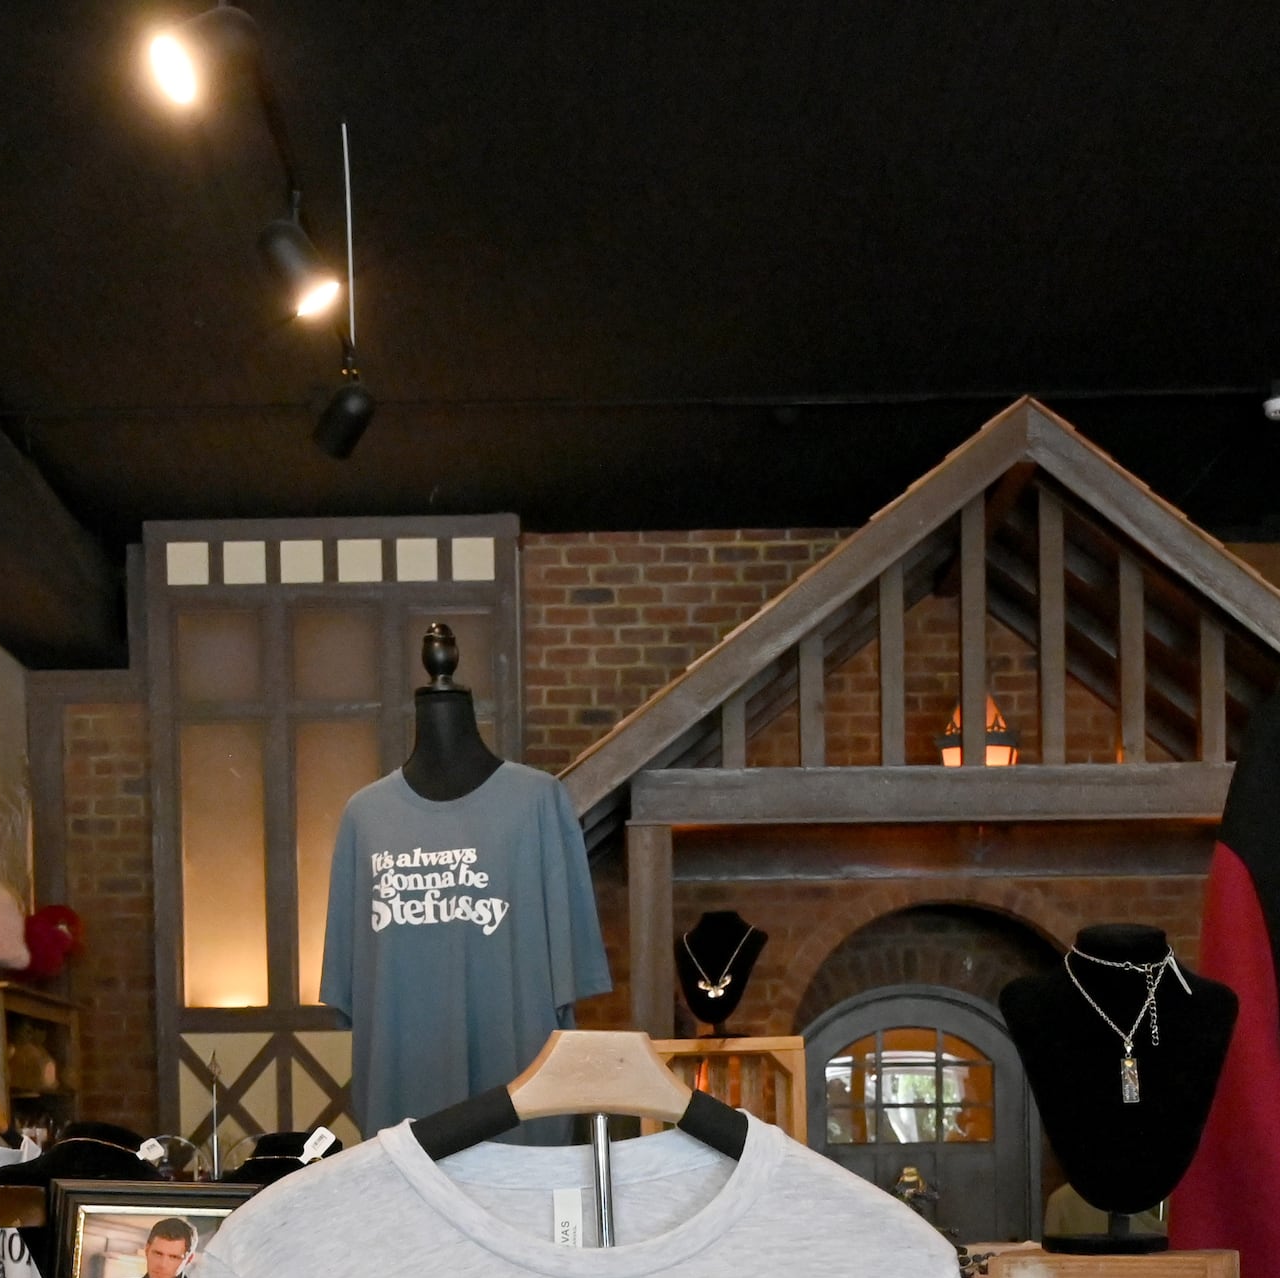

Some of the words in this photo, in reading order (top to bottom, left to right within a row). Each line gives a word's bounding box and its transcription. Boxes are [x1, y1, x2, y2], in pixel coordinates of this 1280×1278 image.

[371, 851, 395, 878] It's
[396, 848, 478, 870] always
[372, 868, 456, 899] gonna
[459, 864, 489, 888] be
